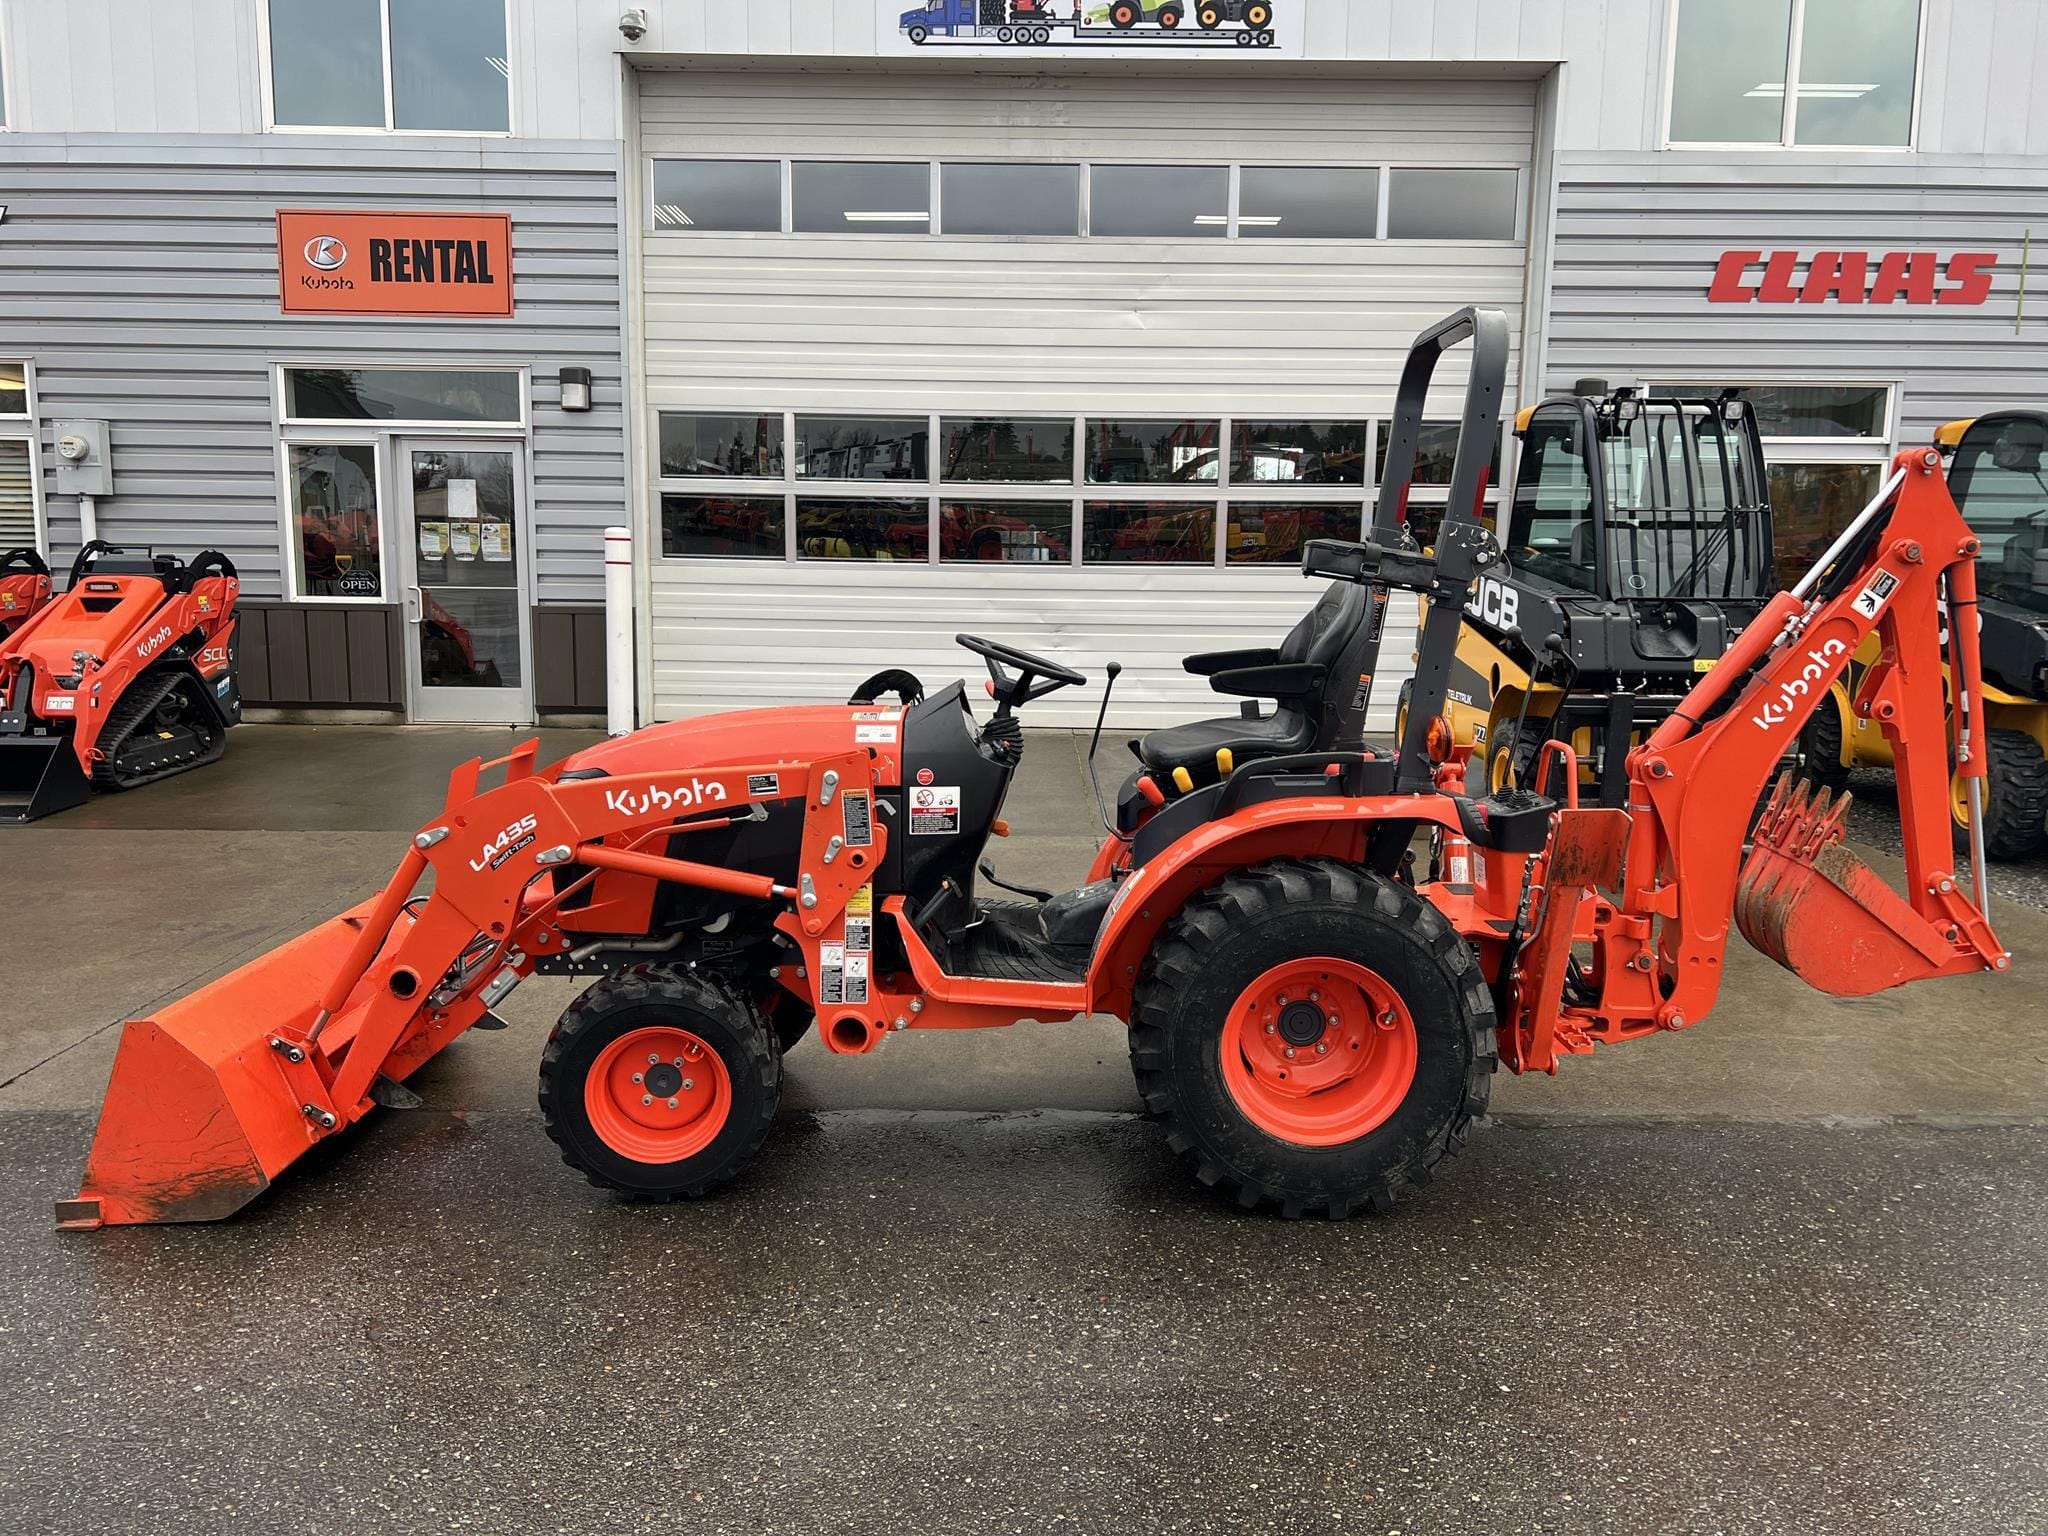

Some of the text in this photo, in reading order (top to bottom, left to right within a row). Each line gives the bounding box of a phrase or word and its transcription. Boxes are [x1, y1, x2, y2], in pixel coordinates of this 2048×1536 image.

[369, 238, 494, 284] RENTAL
[1707, 251, 1999, 305] CLAAS
[301, 275, 354, 290] Kubota
[340, 580, 375, 590] OPEN
[1471, 576, 1519, 631] JCB
[137, 624, 172, 657] Kubota
[203, 647, 226, 662] SCL
[1752, 639, 1846, 731] Kubota
[605, 778, 727, 816] Kubota
[469, 813, 537, 872] LA435
[492, 834, 535, 869] Swift-Tach
